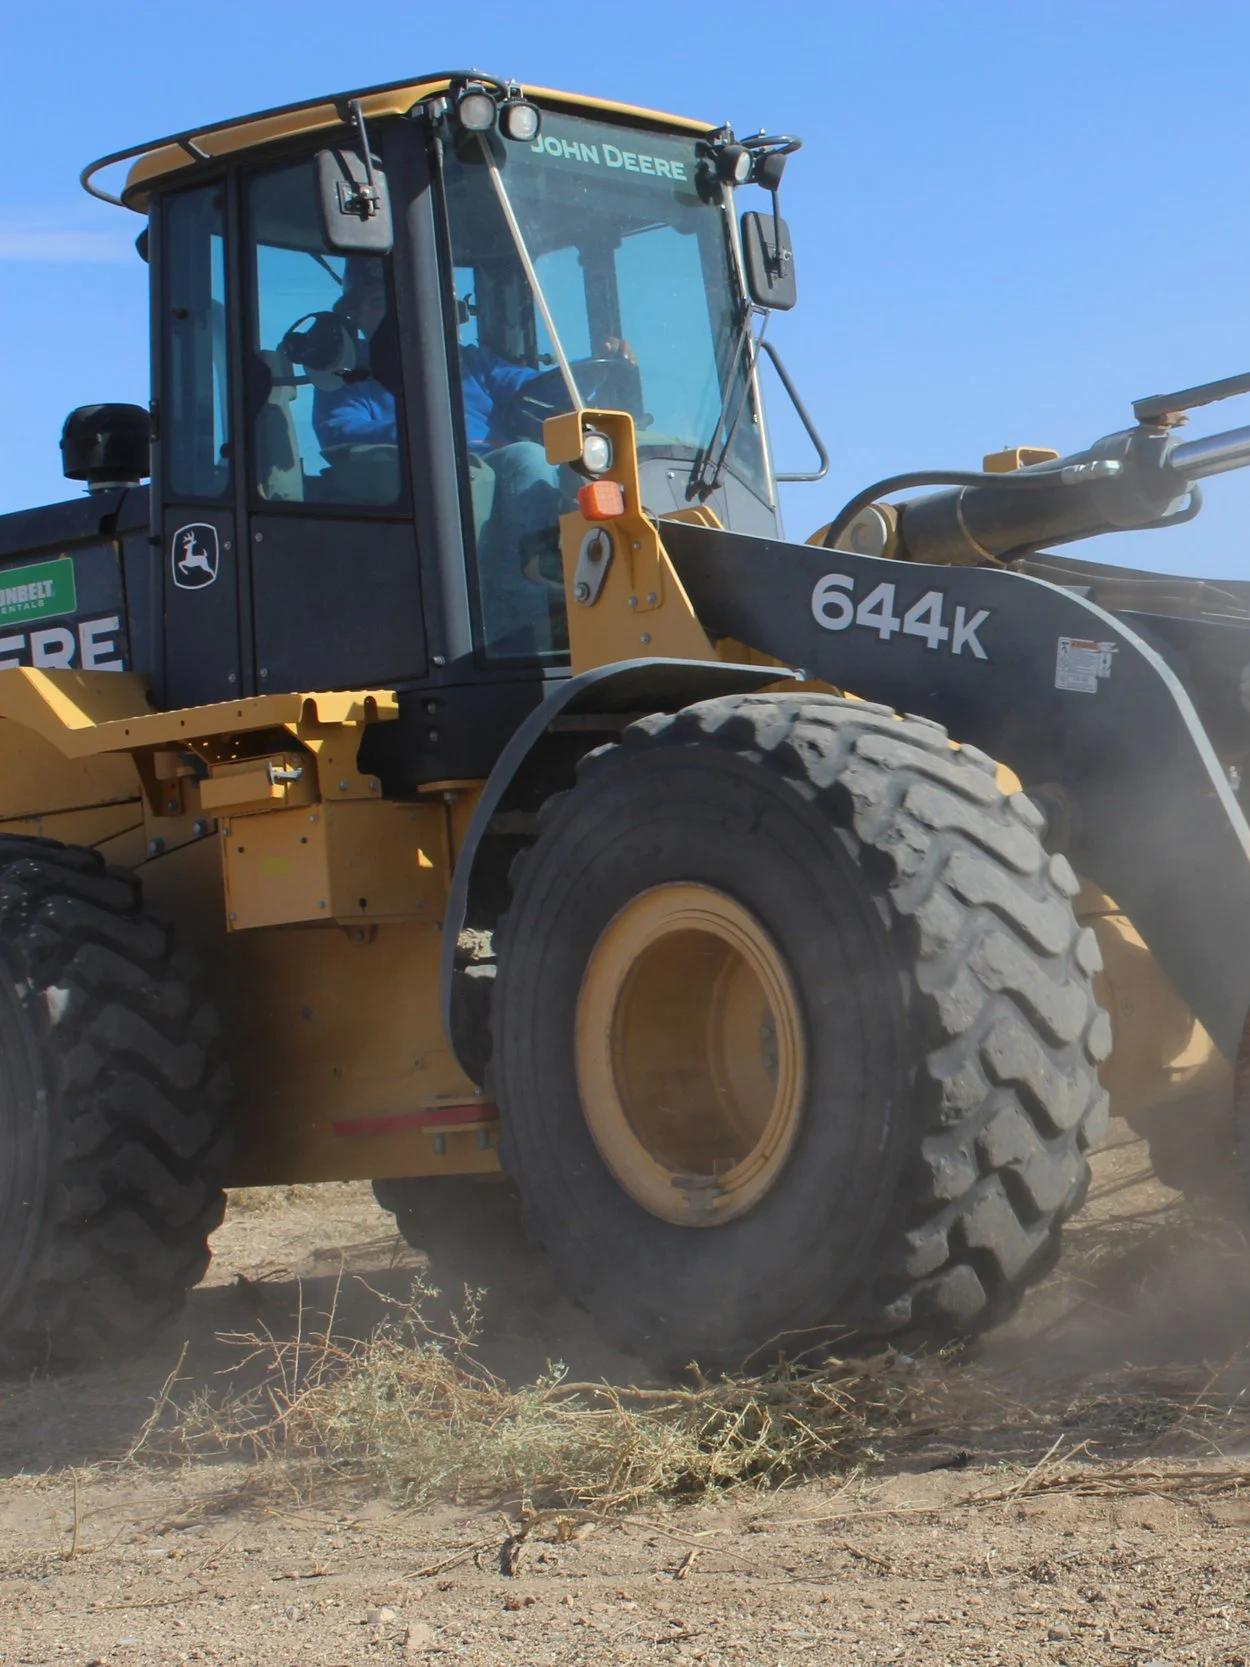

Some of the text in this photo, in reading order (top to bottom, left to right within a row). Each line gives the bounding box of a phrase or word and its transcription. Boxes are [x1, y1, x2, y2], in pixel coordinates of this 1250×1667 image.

[531, 133, 688, 181] JOHN DEERE
[811, 573, 991, 660] 644K
